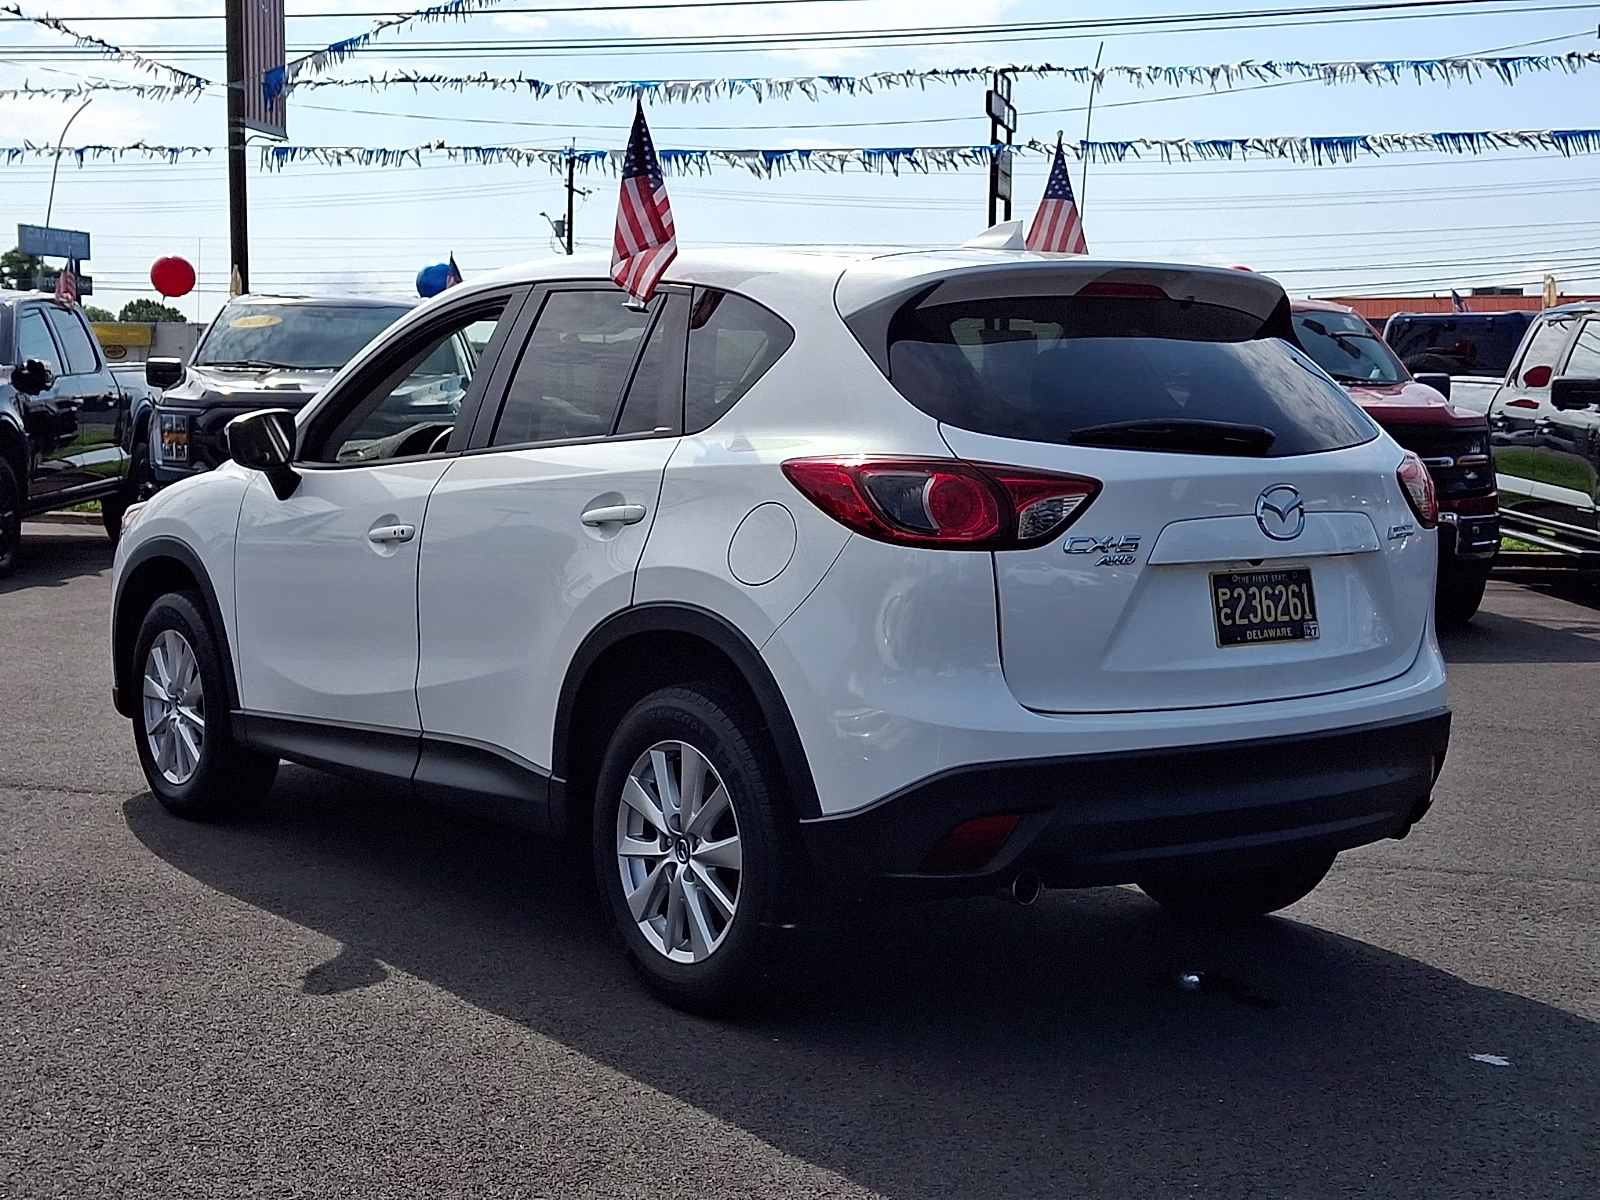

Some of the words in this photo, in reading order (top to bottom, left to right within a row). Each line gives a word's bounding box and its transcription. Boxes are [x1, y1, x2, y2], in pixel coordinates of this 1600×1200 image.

[1063, 535, 1141, 553] CX-5
[1095, 555, 1136, 567] AWD
[1247, 627, 1292, 639] DELAWARE
